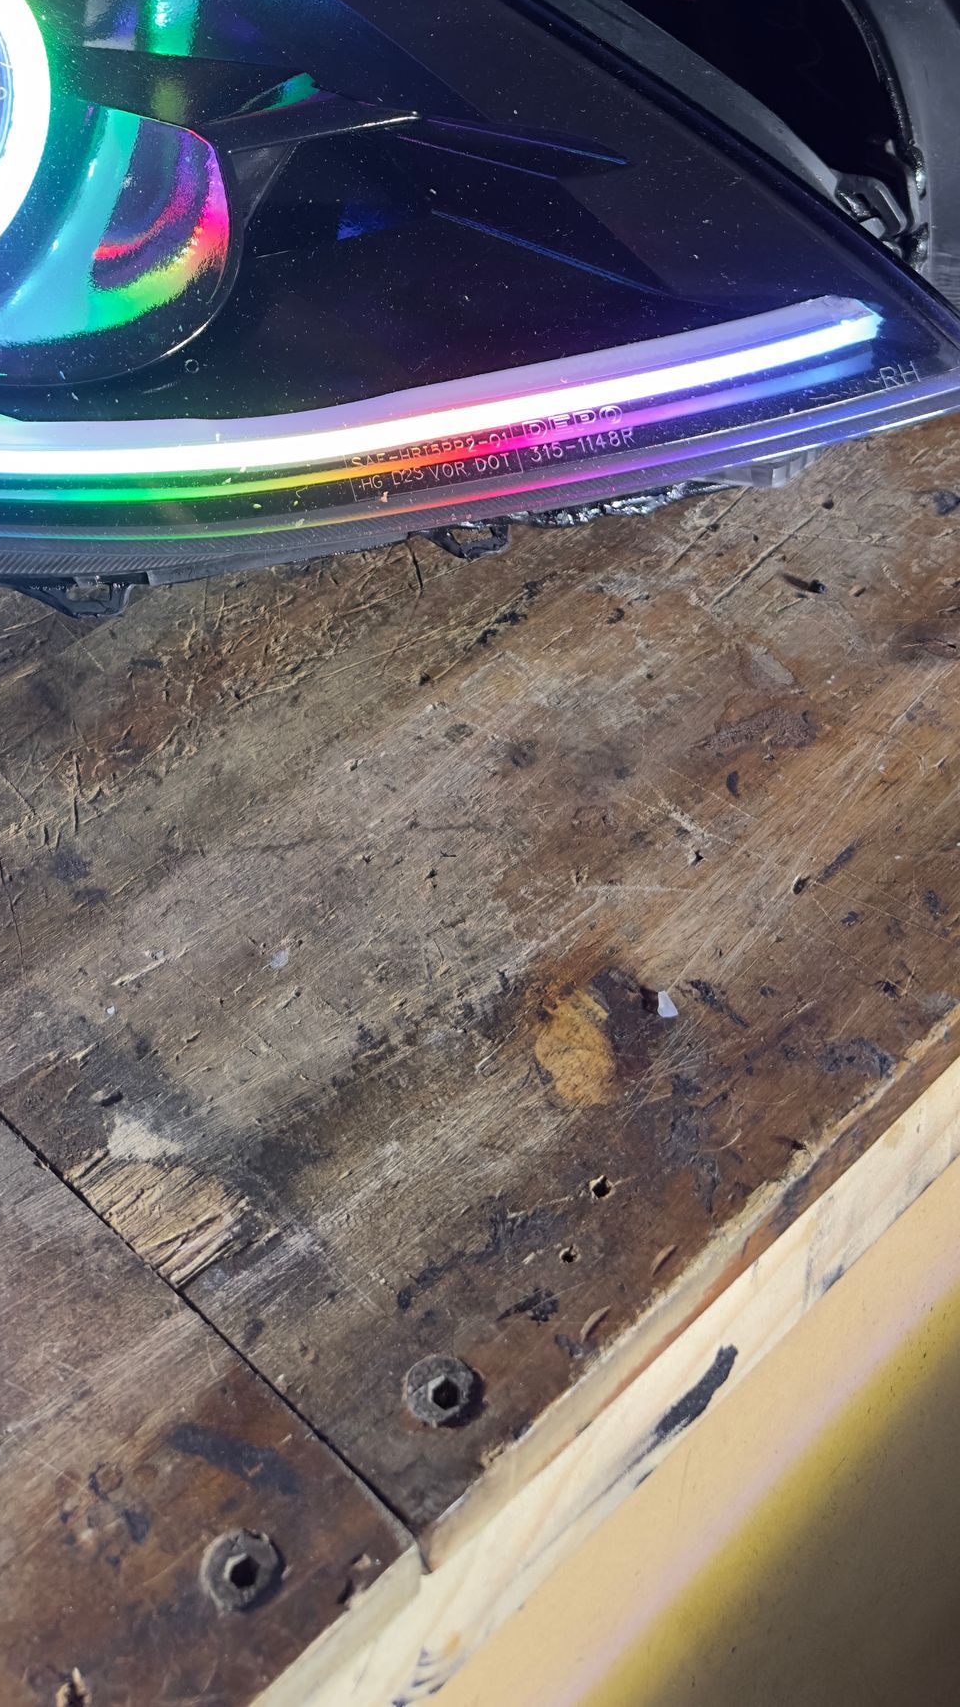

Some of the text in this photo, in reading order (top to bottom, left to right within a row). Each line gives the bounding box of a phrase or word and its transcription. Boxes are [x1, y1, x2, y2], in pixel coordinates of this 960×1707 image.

[880, 360, 920, 388] RH
[522, 405, 623, 439] DEPO
[530, 428, 636, 462] 315-1148R
[360, 453, 510, 491] HG D2S VOR DOT
